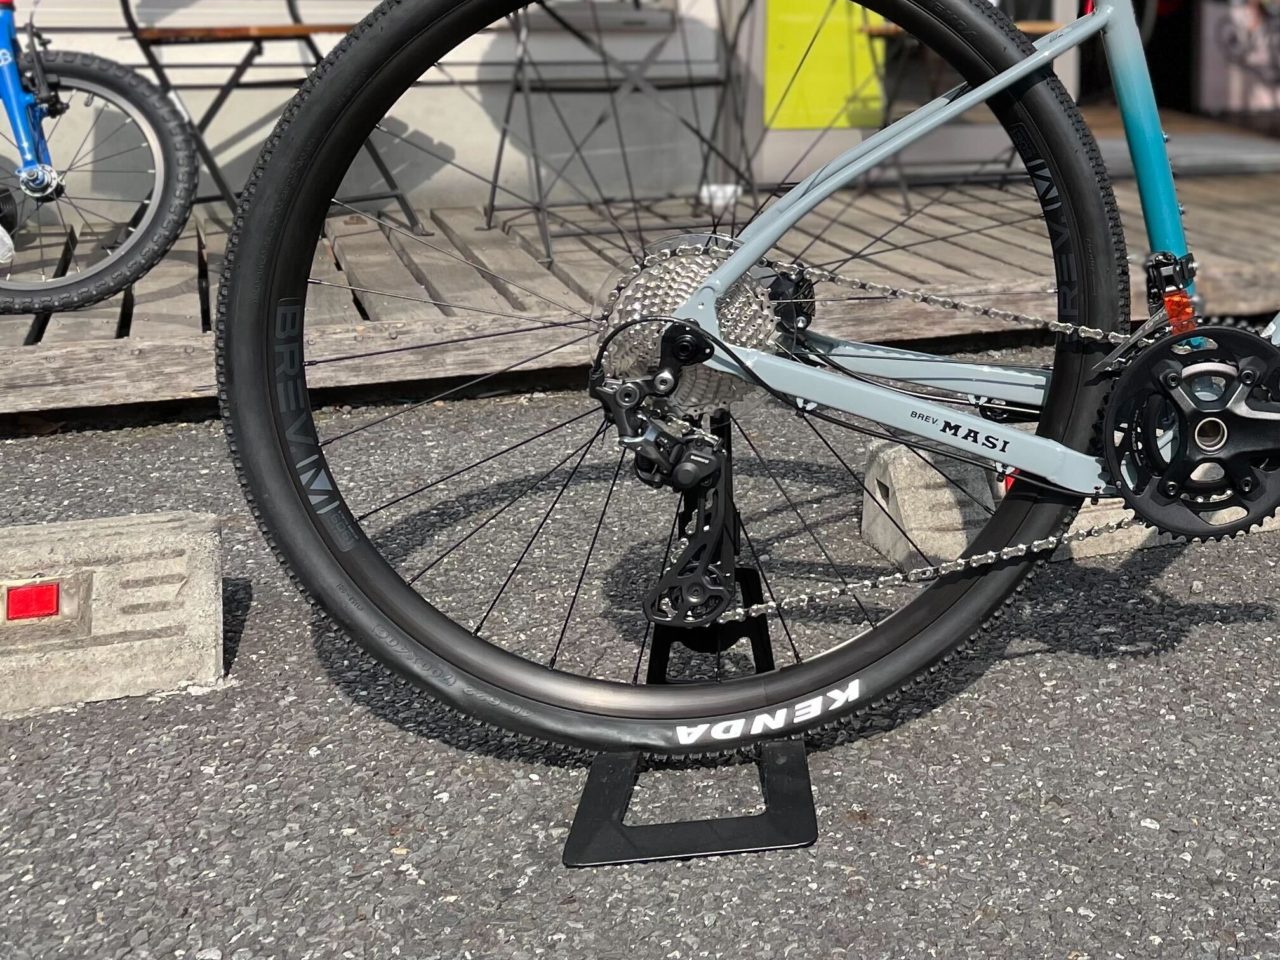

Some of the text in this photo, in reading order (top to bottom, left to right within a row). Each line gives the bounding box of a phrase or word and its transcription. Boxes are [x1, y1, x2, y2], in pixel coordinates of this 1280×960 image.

[910, 410, 1010, 453] BREV. MASI
[675, 679, 861, 745] KENDA
